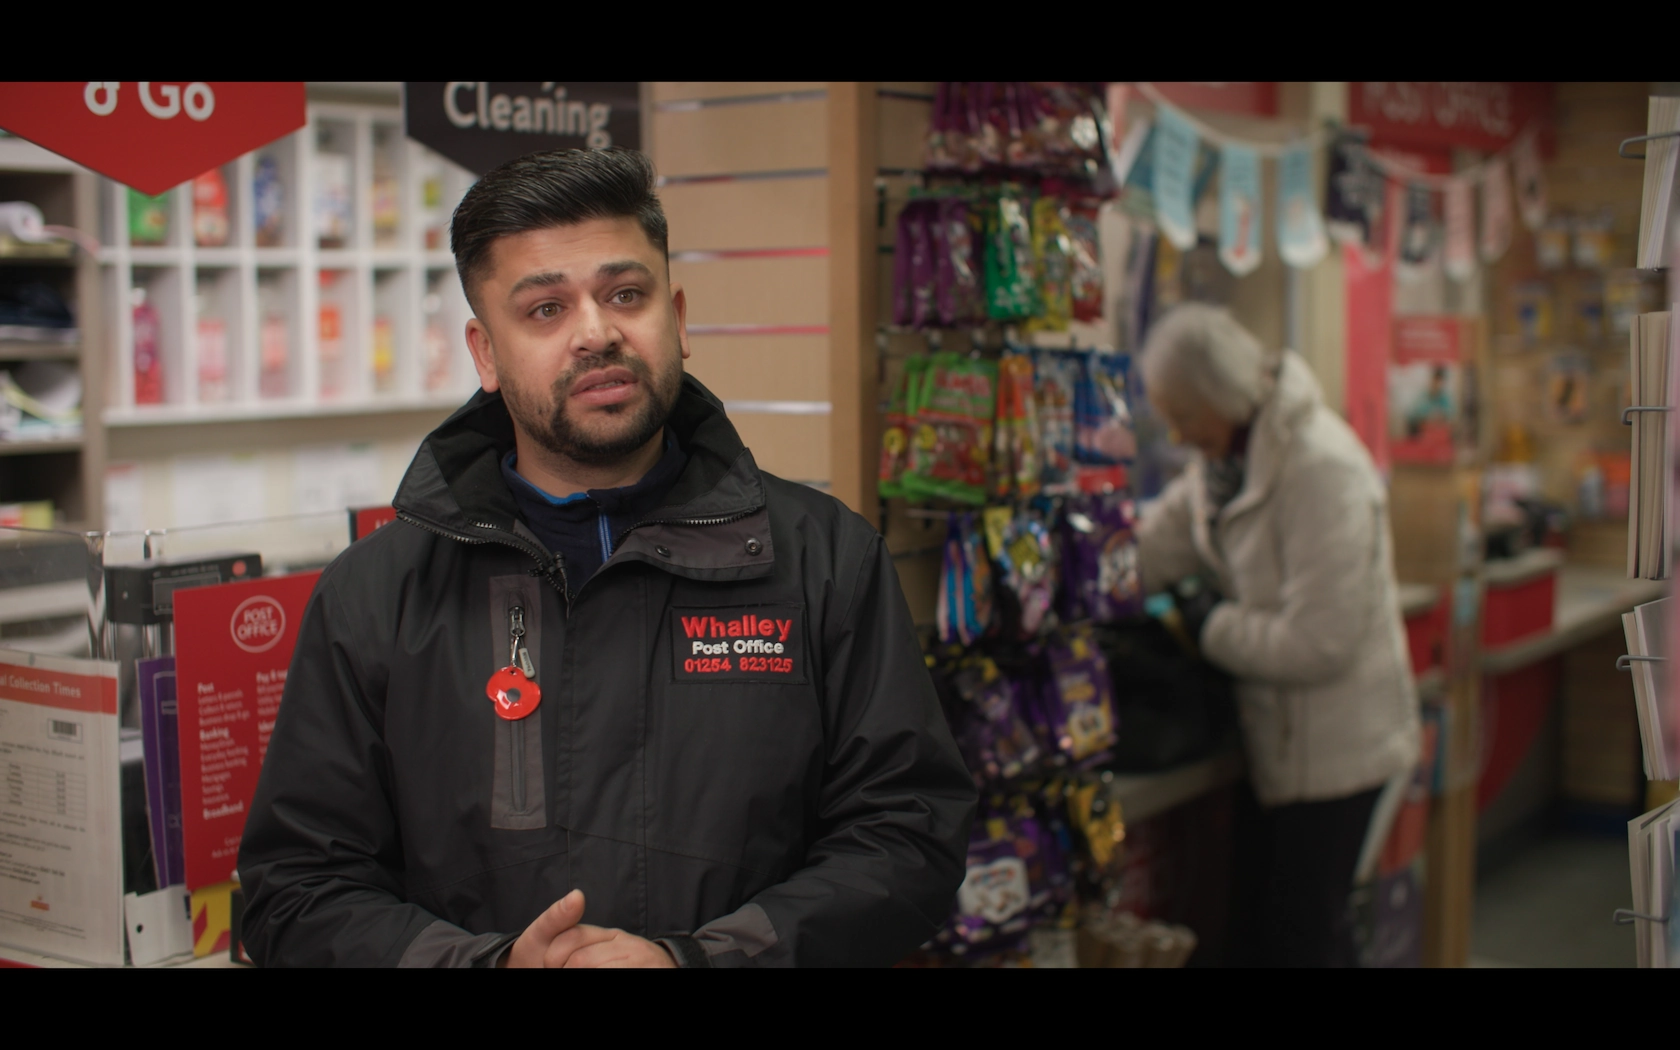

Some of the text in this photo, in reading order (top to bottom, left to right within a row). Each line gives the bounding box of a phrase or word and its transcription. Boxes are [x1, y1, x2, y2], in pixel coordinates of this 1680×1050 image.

[138, 82, 215, 122] Go
[443, 82, 612, 151] Cleaning
[244, 606, 273, 623] POST
[237, 619, 278, 640] OFFICE
[681, 614, 793, 642] Whalley
[692, 639, 785, 655] Post Office
[684, 656, 793, 673] 01254 823125
[9, 675, 50, 693] Collection
[53, 682, 81, 698] Times
[199, 727, 230, 741] Banking
[203, 799, 244, 821] Broadband
